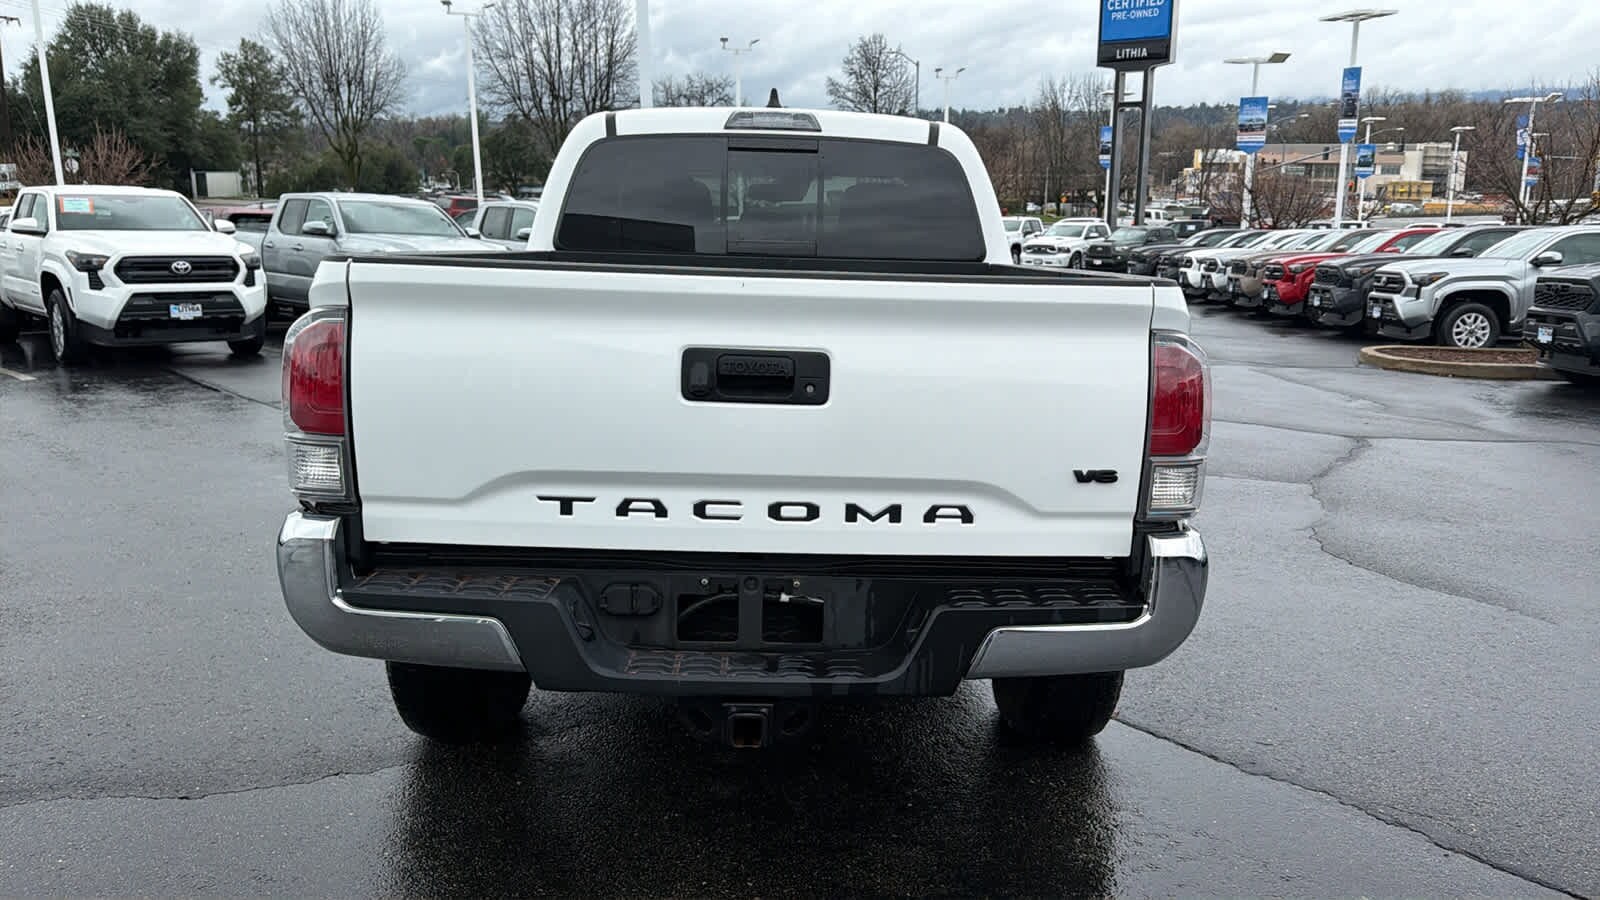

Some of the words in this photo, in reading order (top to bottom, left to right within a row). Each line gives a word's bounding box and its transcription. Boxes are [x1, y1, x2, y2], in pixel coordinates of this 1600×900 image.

[1111, 8, 1159, 20] PRE-OWNED
[1116, 48, 1148, 58] LITHIA
[177, 304, 202, 313] LITHIA
[1073, 469, 1119, 484] V6
[537, 495, 975, 525] TACOMA
